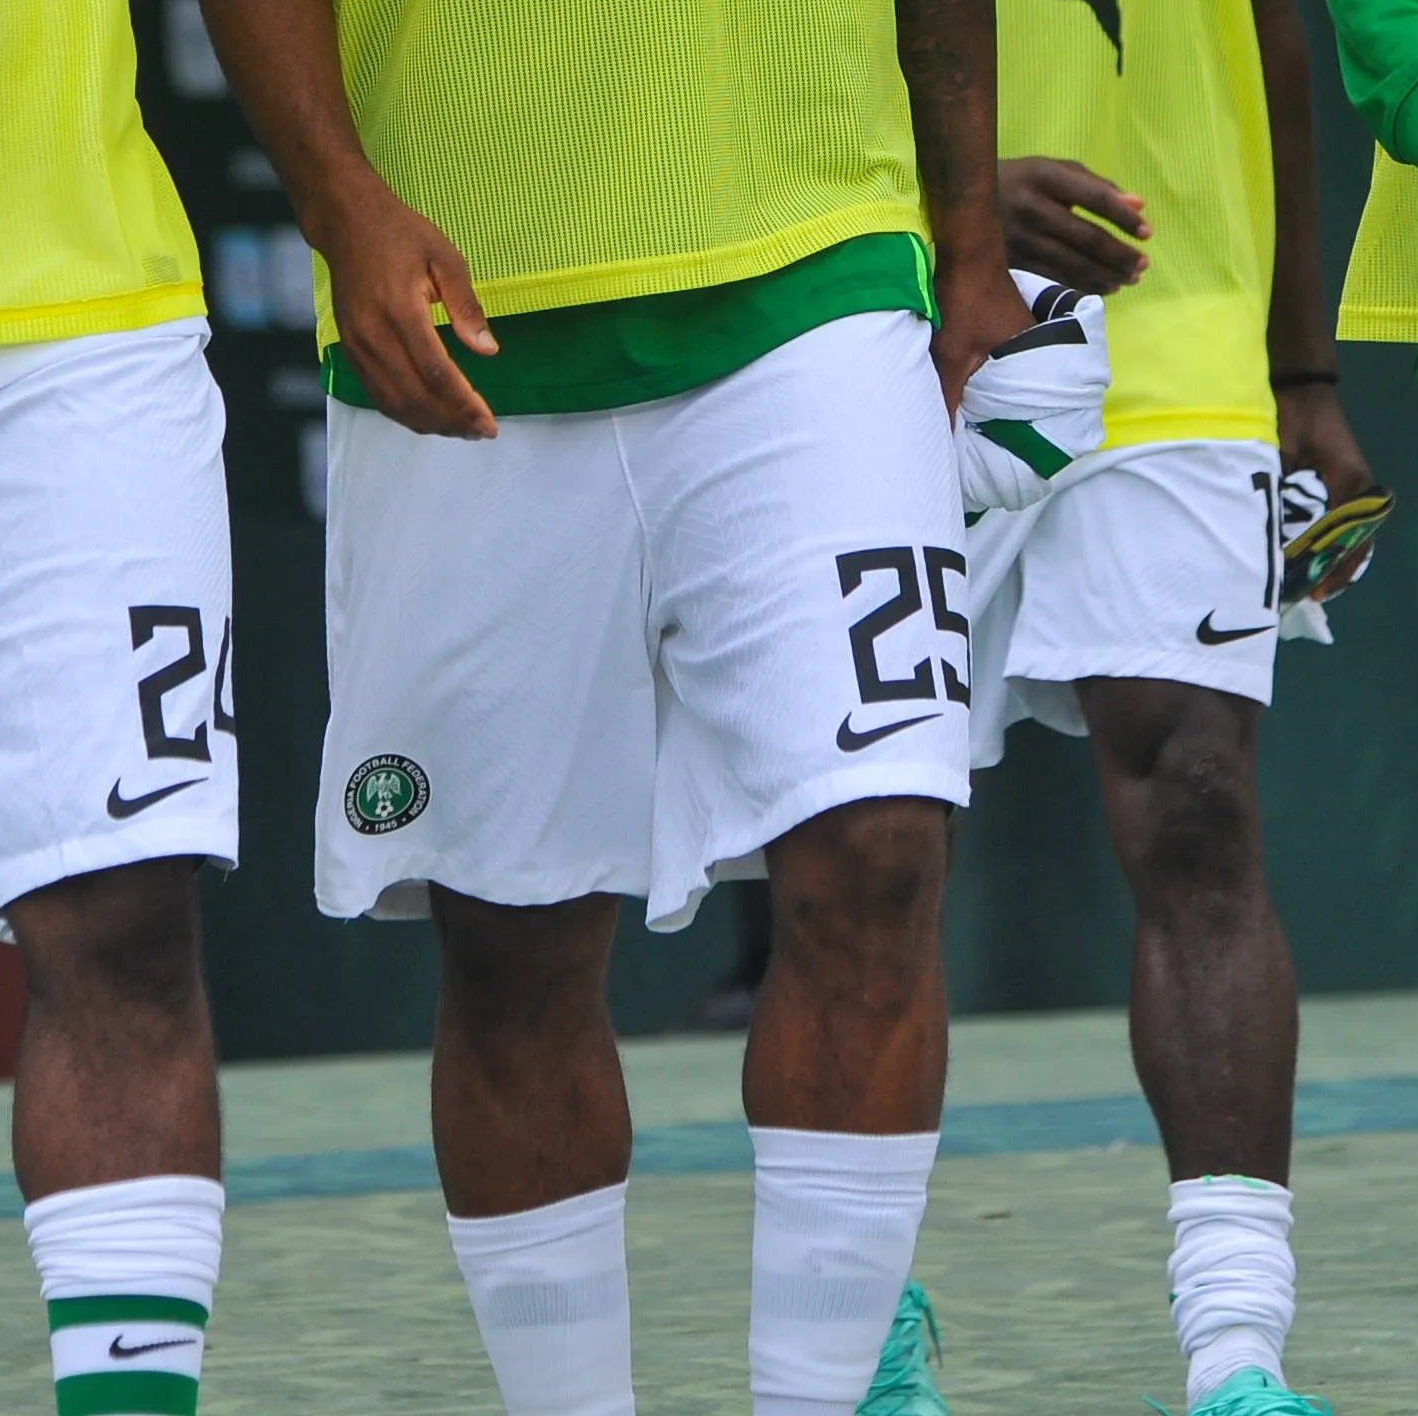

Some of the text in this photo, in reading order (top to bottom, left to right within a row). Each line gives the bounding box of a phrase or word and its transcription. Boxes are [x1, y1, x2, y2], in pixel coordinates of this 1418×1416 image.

[835, 545, 972, 712] 25
[349, 756, 400, 789] FOOTBALL
[401, 760, 427, 817] FEDERATION
